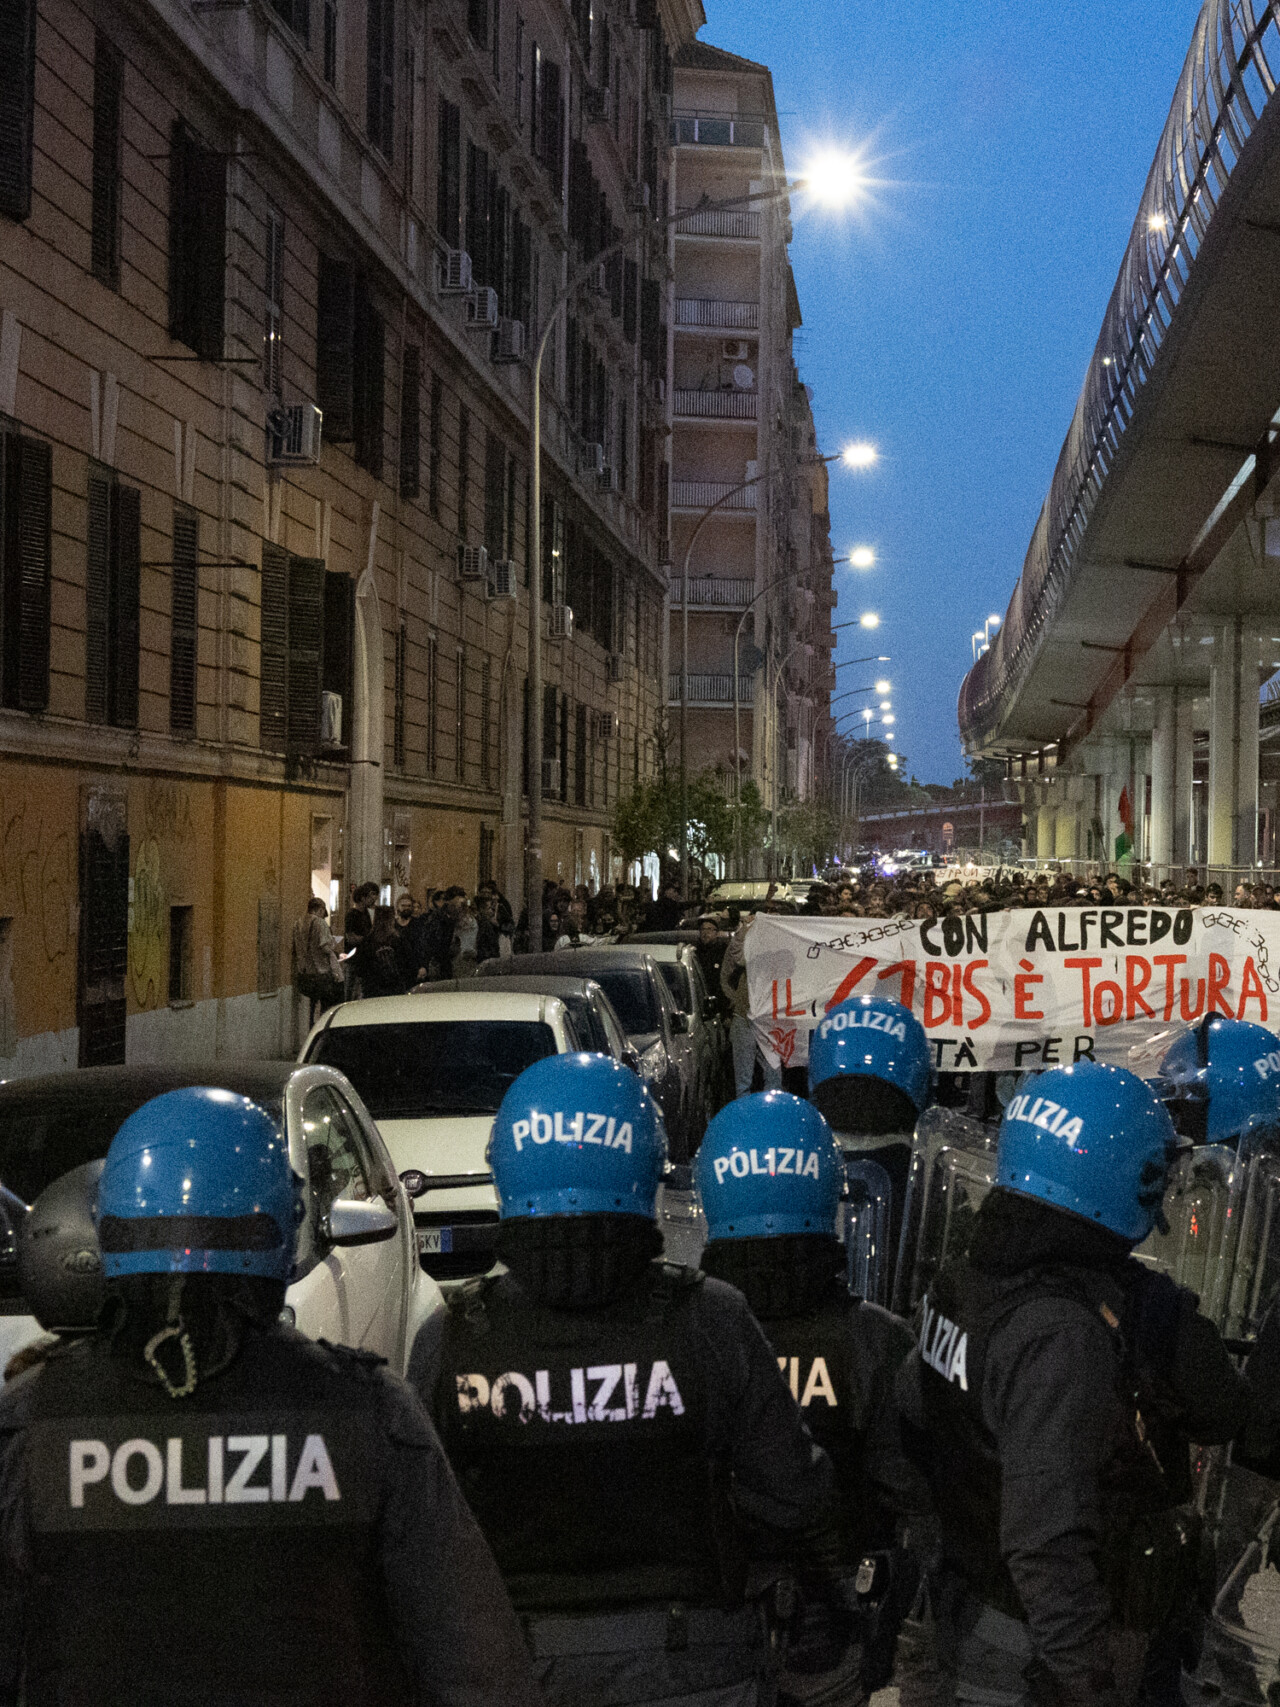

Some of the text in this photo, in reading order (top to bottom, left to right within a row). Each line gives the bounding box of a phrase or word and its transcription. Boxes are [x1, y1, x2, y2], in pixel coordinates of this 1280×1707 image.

[920, 909, 1194, 957] CON ALFREDO
[772, 978, 806, 1020] IL
[1014, 958, 1044, 1020] È
[820, 1010, 907, 1042] POLIZIA
[1015, 1035, 1097, 1067] PER
[513, 1111, 634, 1153] POLIZIA
[1006, 1094, 1084, 1147] OLIZIA
[713, 1147, 820, 1184] POLIZIA
[920, 1293, 969, 1391] LIZIA
[456, 1360, 686, 1425] POLIZIA
[69, 1434, 341, 1508] POLIZIA
